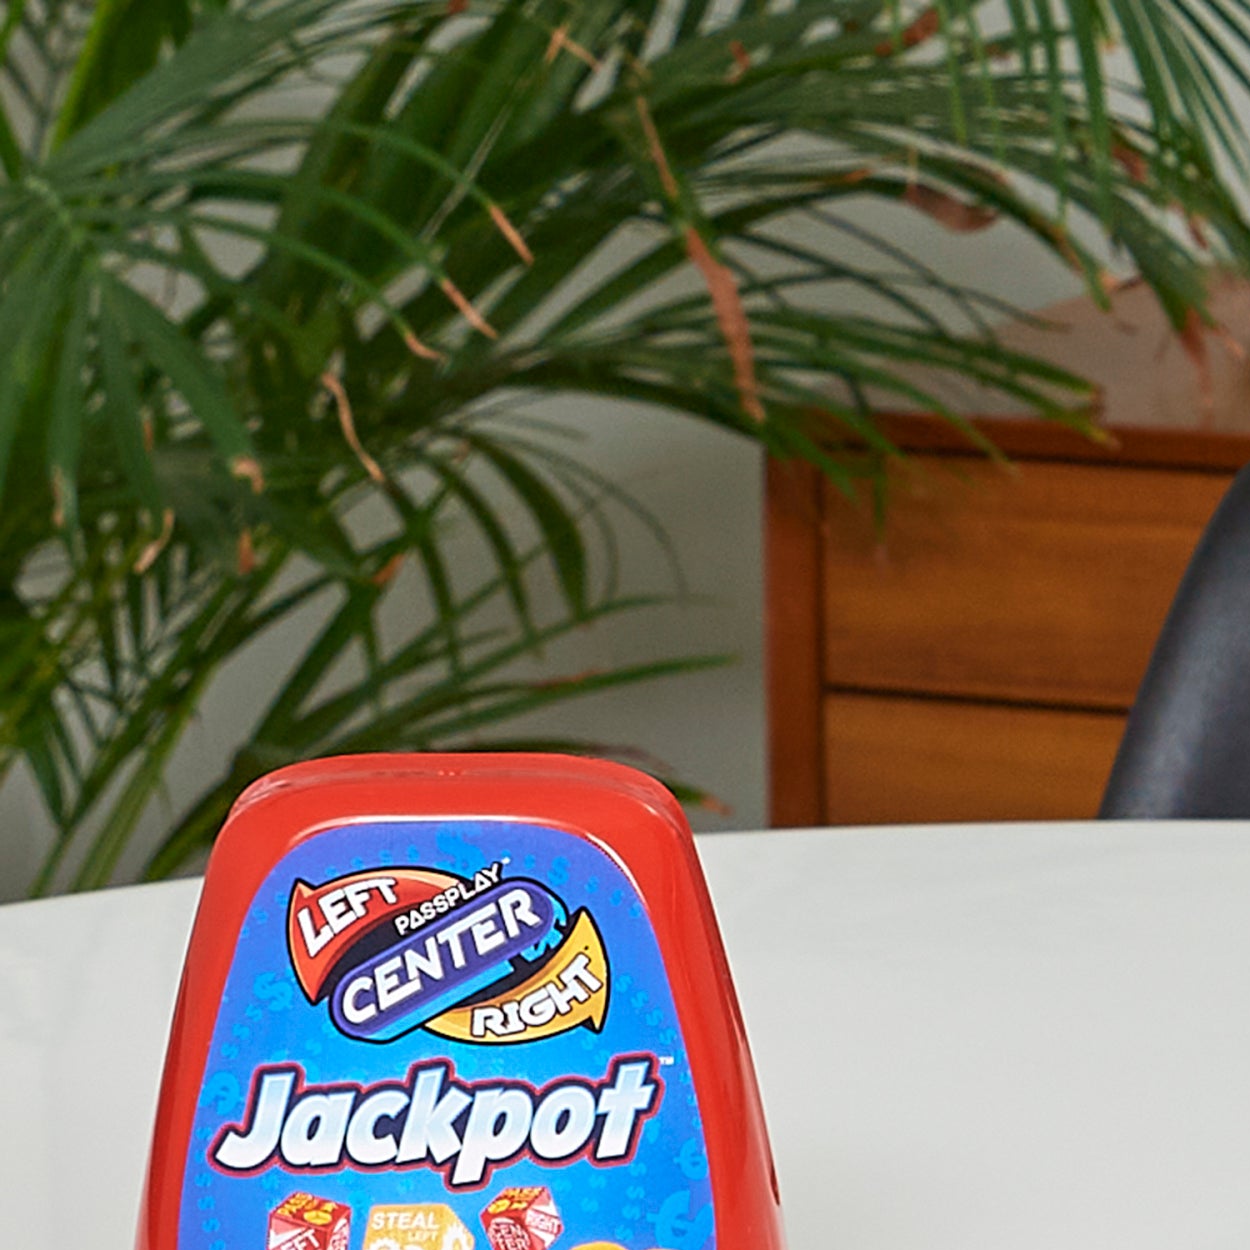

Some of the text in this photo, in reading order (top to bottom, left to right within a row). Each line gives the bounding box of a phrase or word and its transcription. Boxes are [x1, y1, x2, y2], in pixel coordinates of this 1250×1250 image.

[296, 877, 397, 958] LEFT
[394, 862, 500, 936] PASSPLAY
[341, 888, 541, 1025] CENTER
[470, 952, 604, 1038] RIGHT
[213, 1058, 658, 1187] Jackpot
[371, 1211, 440, 1230] STEAL
[407, 1230, 439, 1242] LEFT
